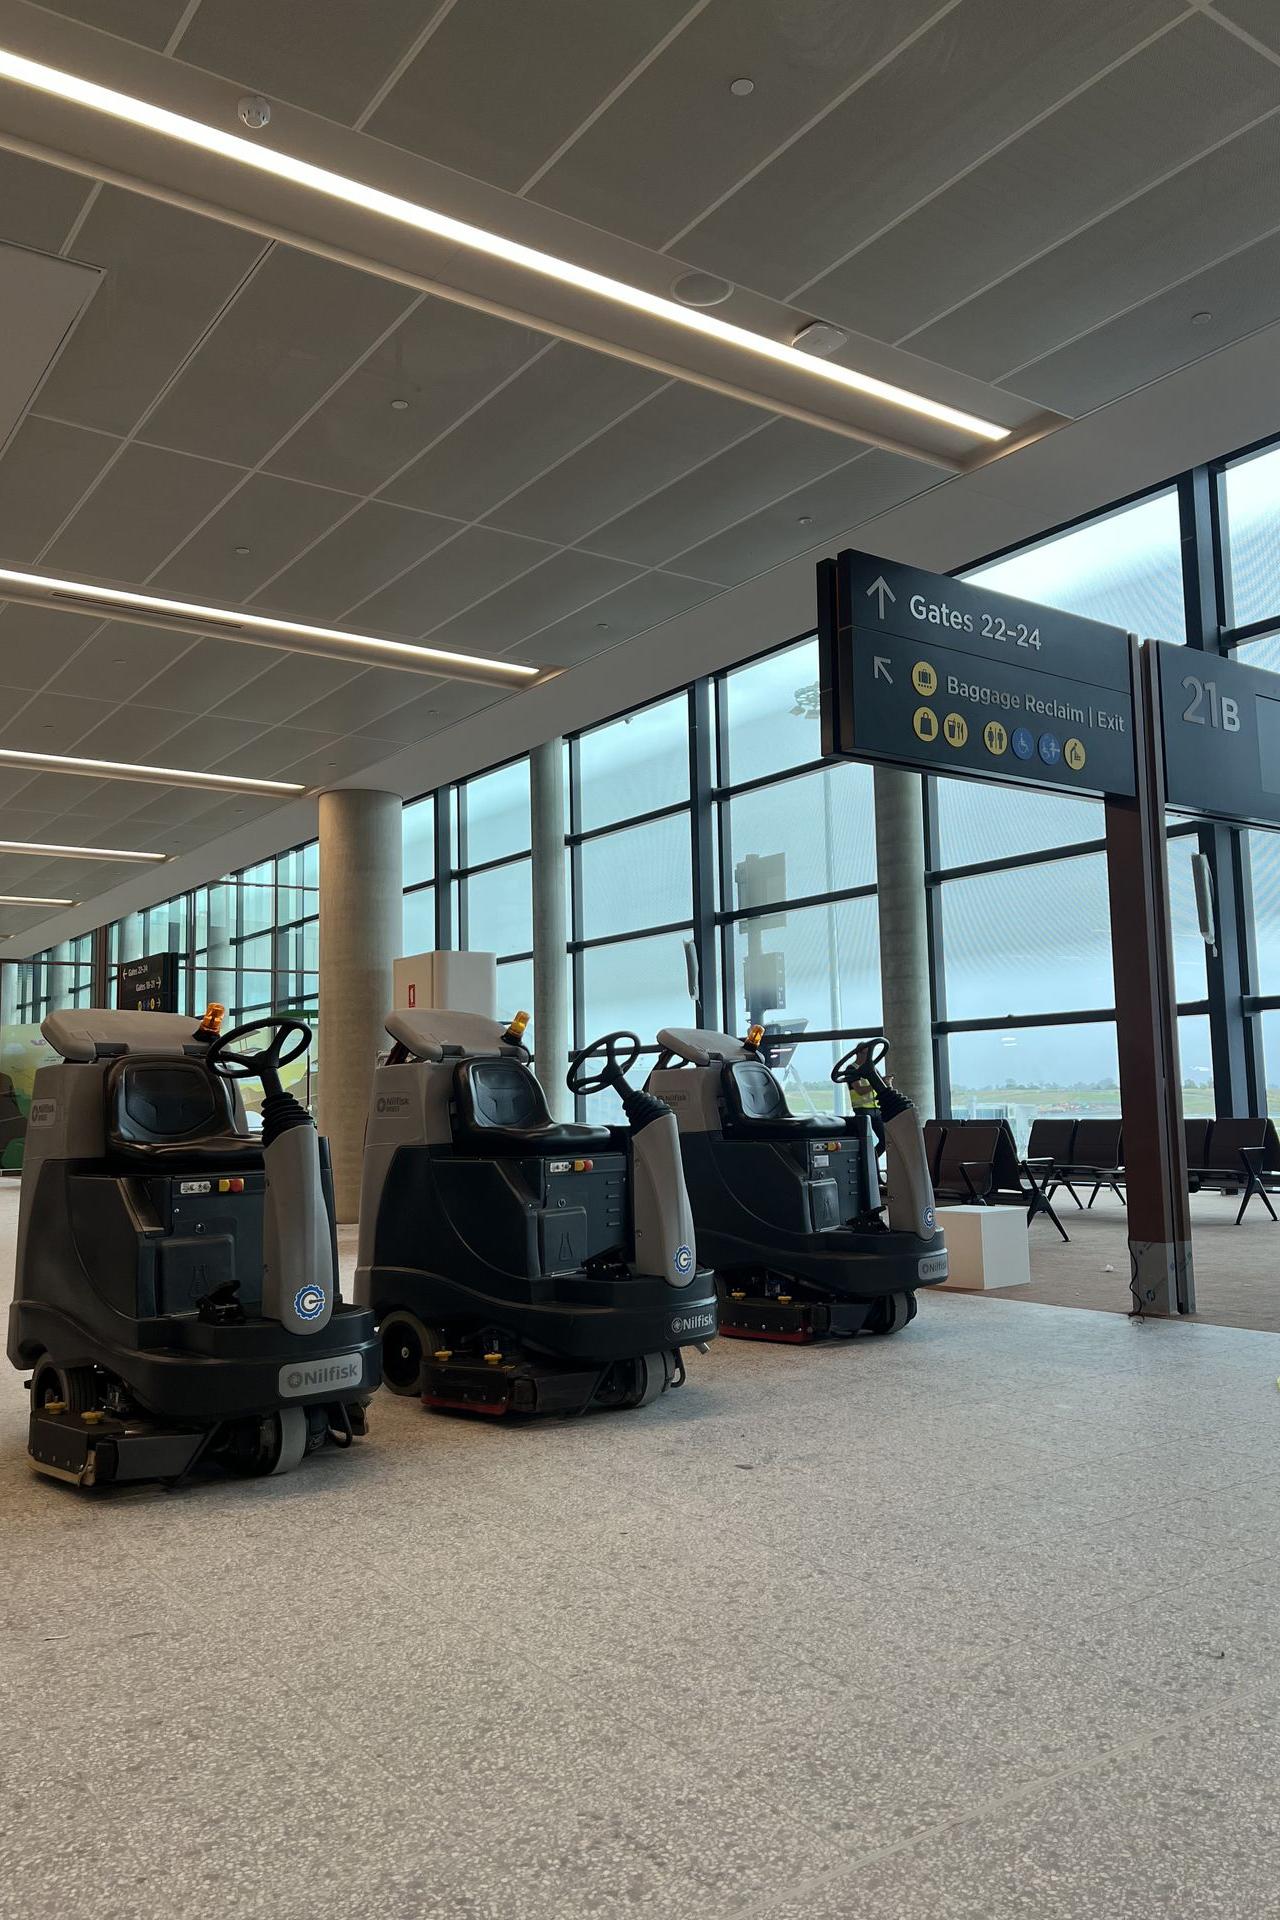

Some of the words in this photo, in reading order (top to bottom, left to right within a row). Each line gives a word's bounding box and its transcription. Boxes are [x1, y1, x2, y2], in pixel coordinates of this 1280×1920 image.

[909, 594, 974, 633] Gates
[980, 613, 1042, 651] 22-24
[946, 675, 1021, 710] Baggage
[1024, 693, 1084, 724] Reclaim
[1096, 710, 1126, 733] Exit
[1180, 675, 1241, 732] 21B
[683, 1313, 713, 1331] Nilfisk
[303, 1363, 358, 1386] Nilfisk
